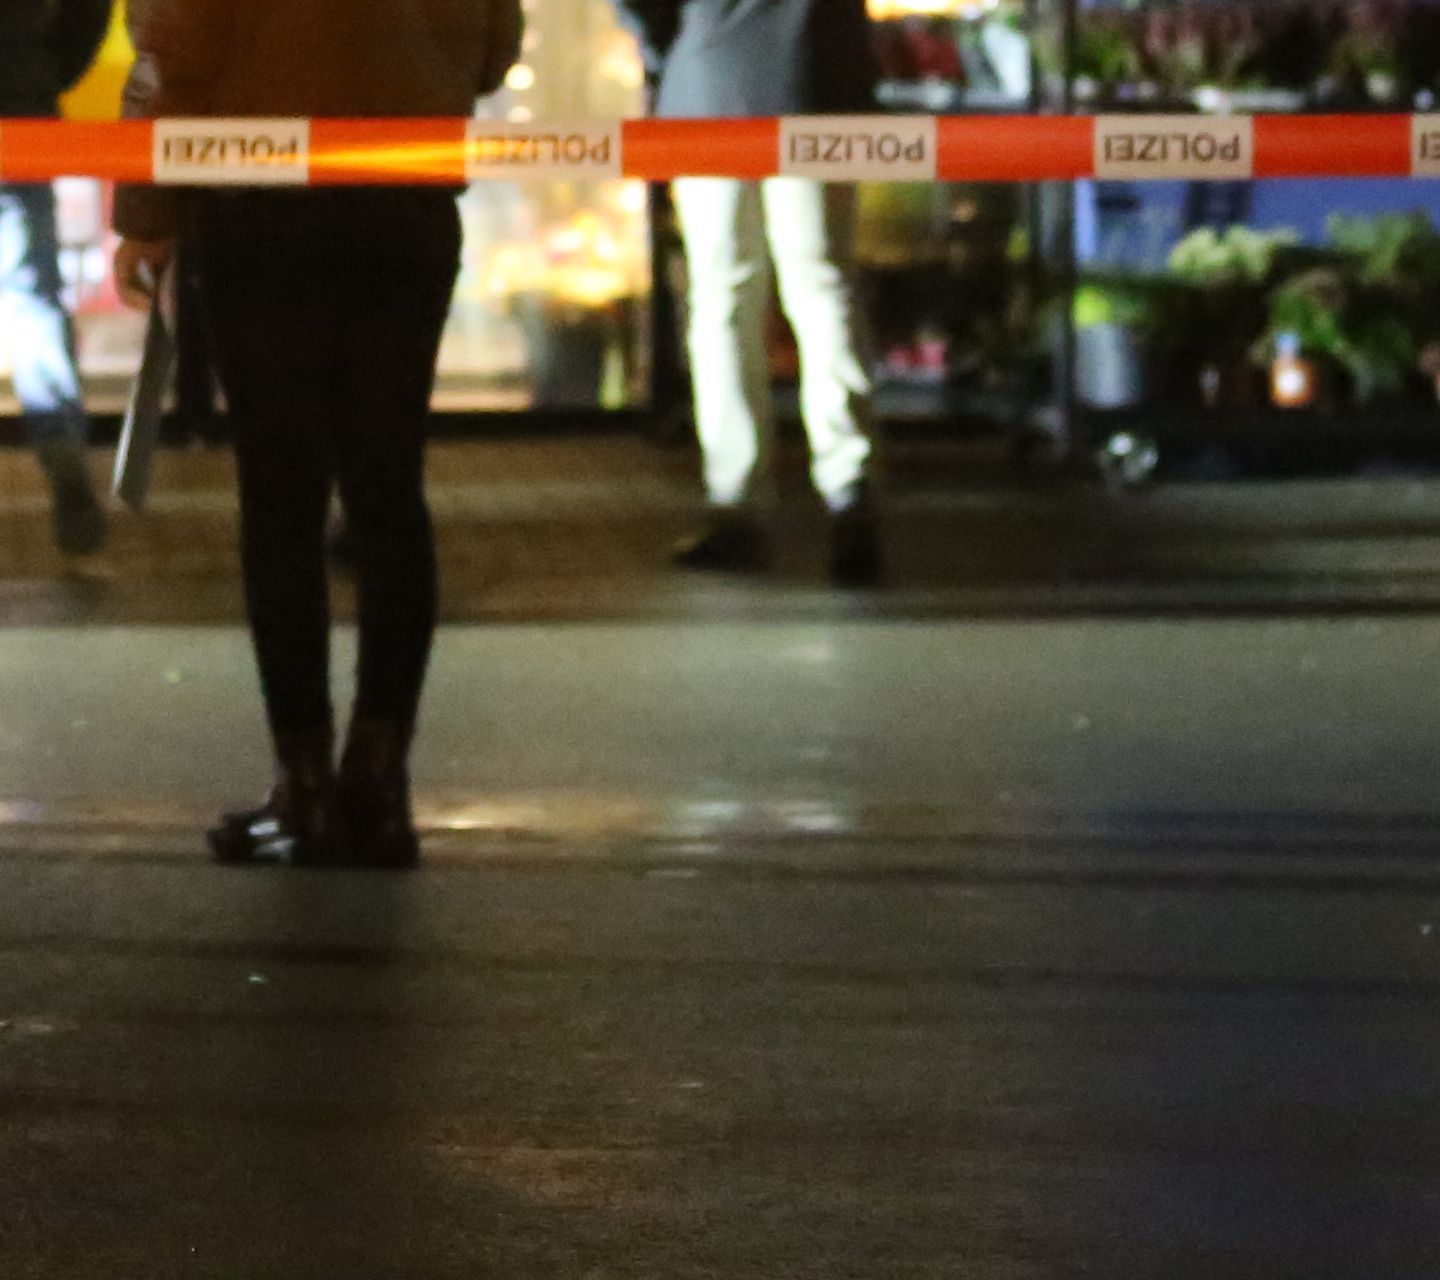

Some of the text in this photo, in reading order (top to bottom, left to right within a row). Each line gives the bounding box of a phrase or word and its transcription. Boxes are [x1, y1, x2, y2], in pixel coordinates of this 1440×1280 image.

[163, 134, 298, 165] POLIZEI
[789, 132, 925, 163] POLIZEI
[1104, 132, 1241, 163] POLIZEI
